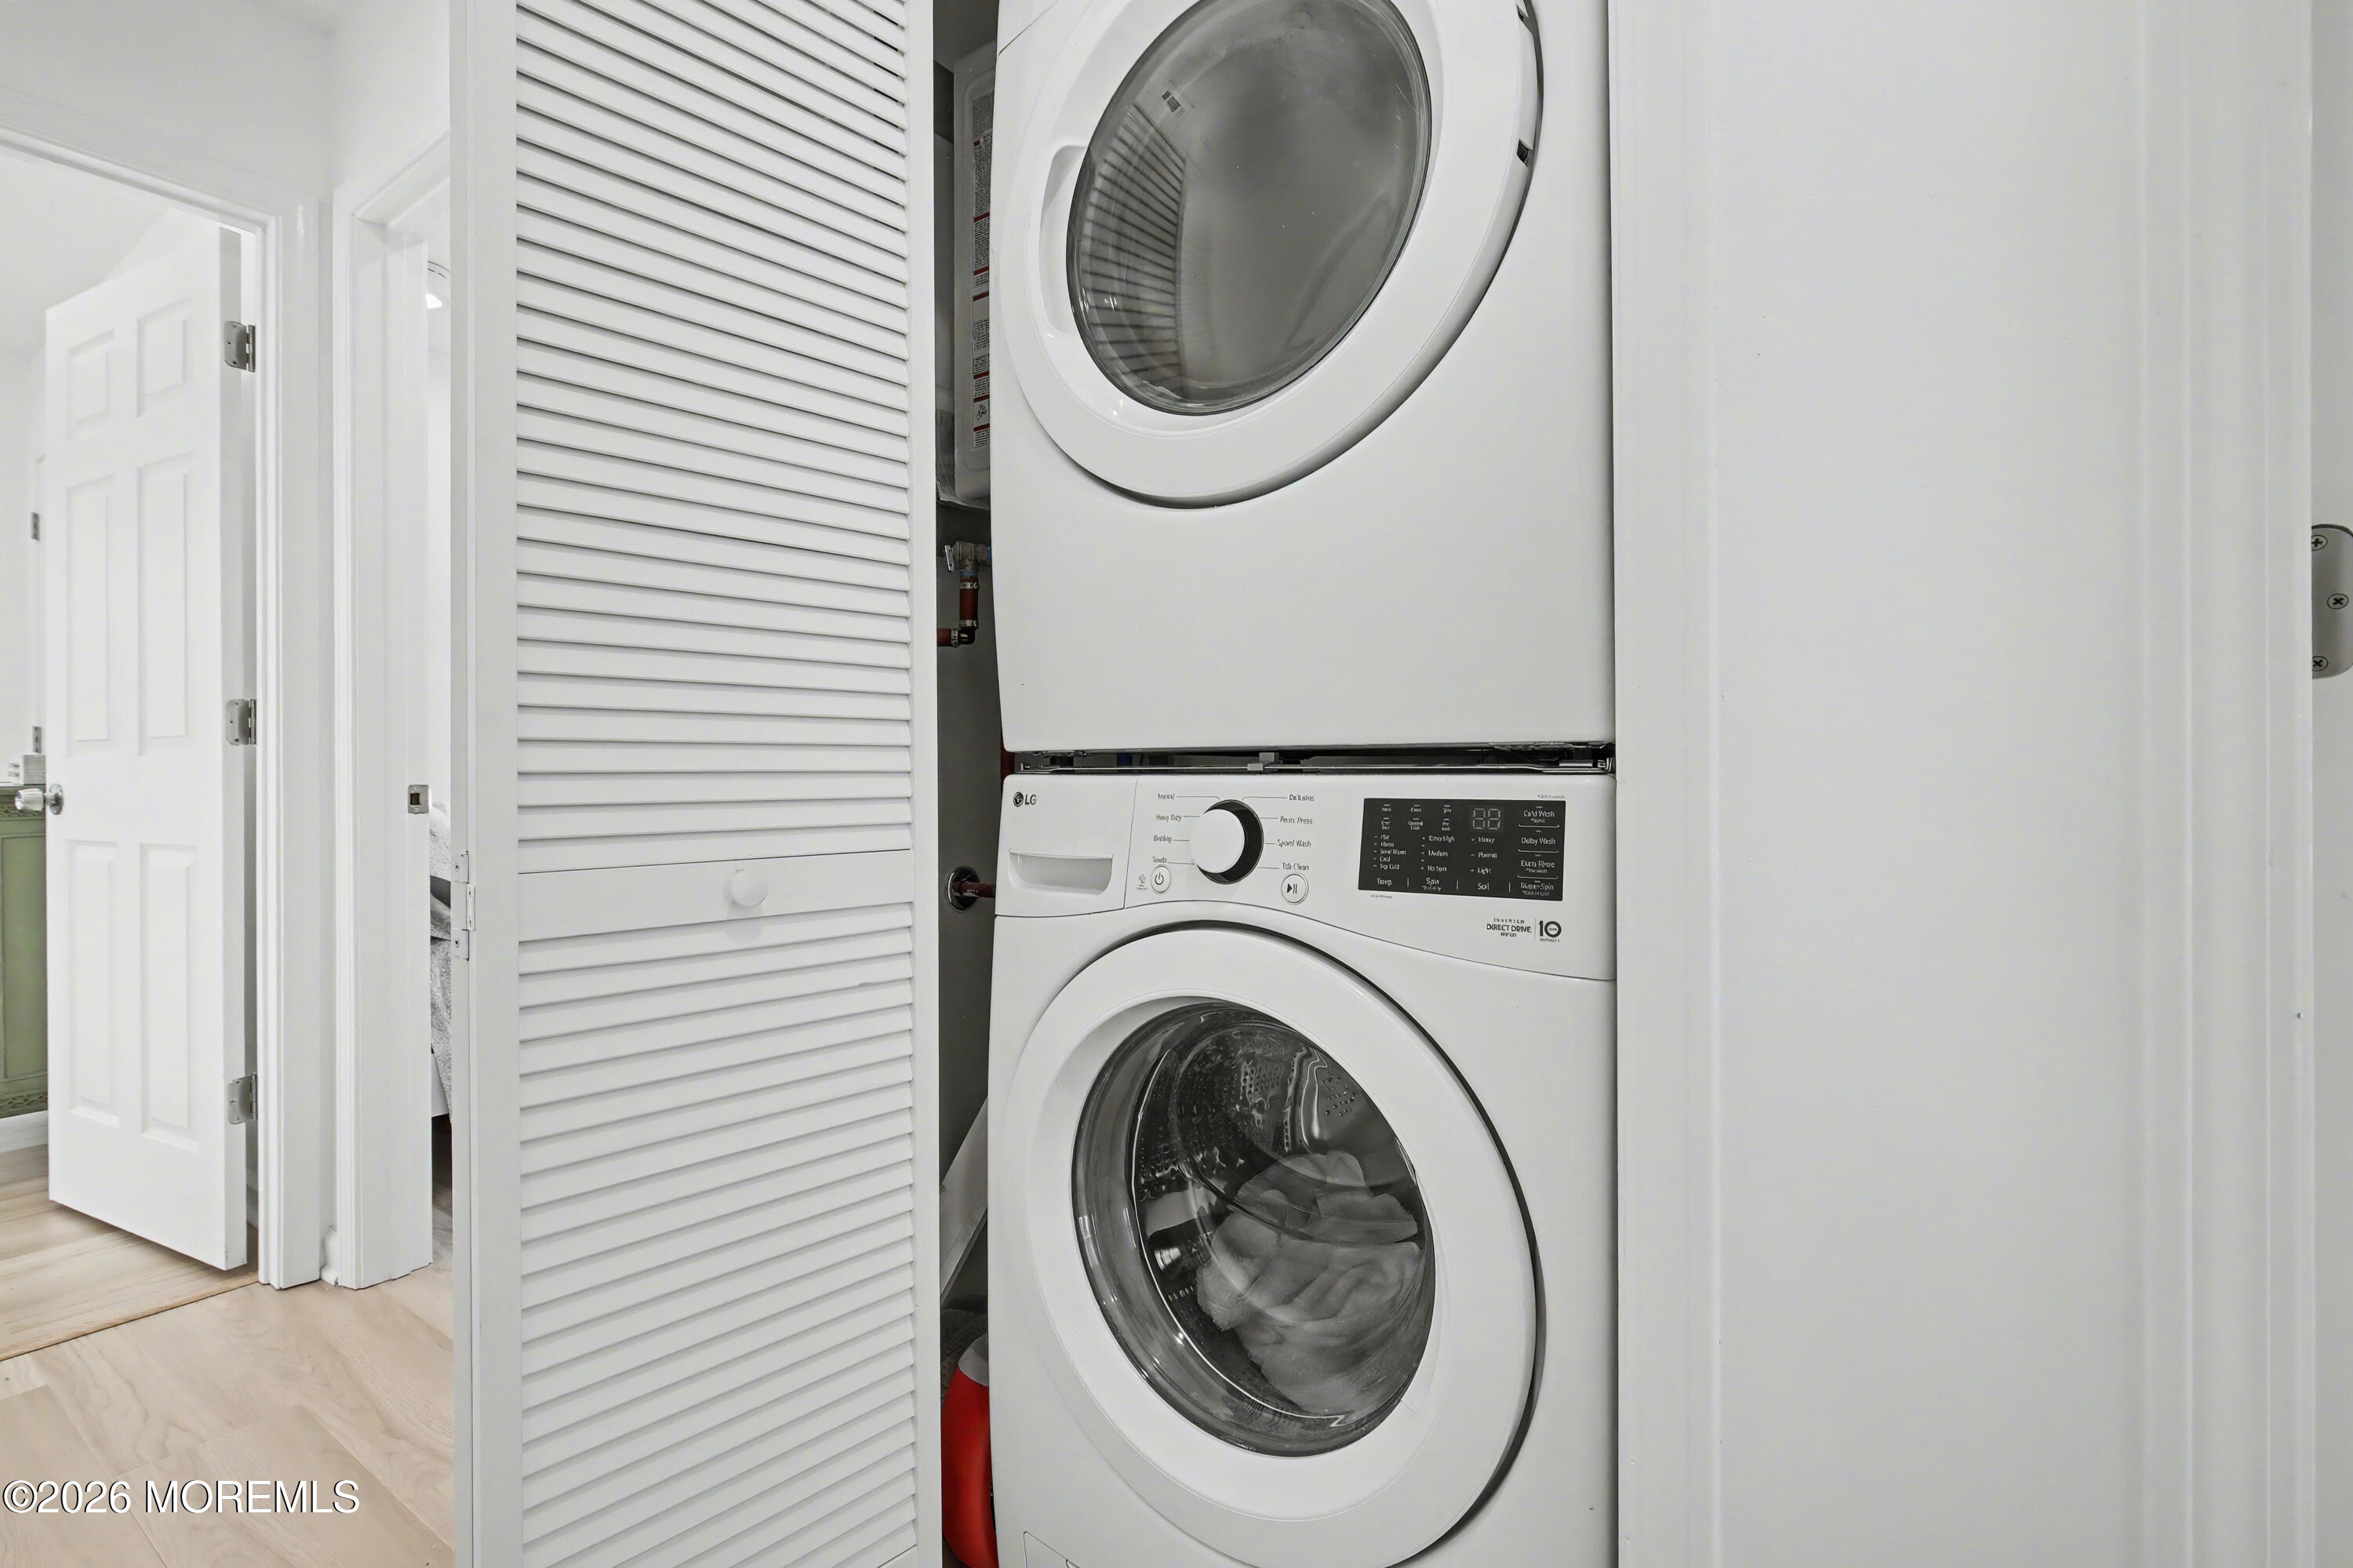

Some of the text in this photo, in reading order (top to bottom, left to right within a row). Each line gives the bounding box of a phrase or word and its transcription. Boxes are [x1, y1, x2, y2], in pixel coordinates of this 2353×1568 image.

[1024, 794, 1037, 806] LG
[1477, 882, 1490, 891] Soil
[1511, 925, 1532, 933] DRIVE
[1539, 920, 1562, 938] 10
